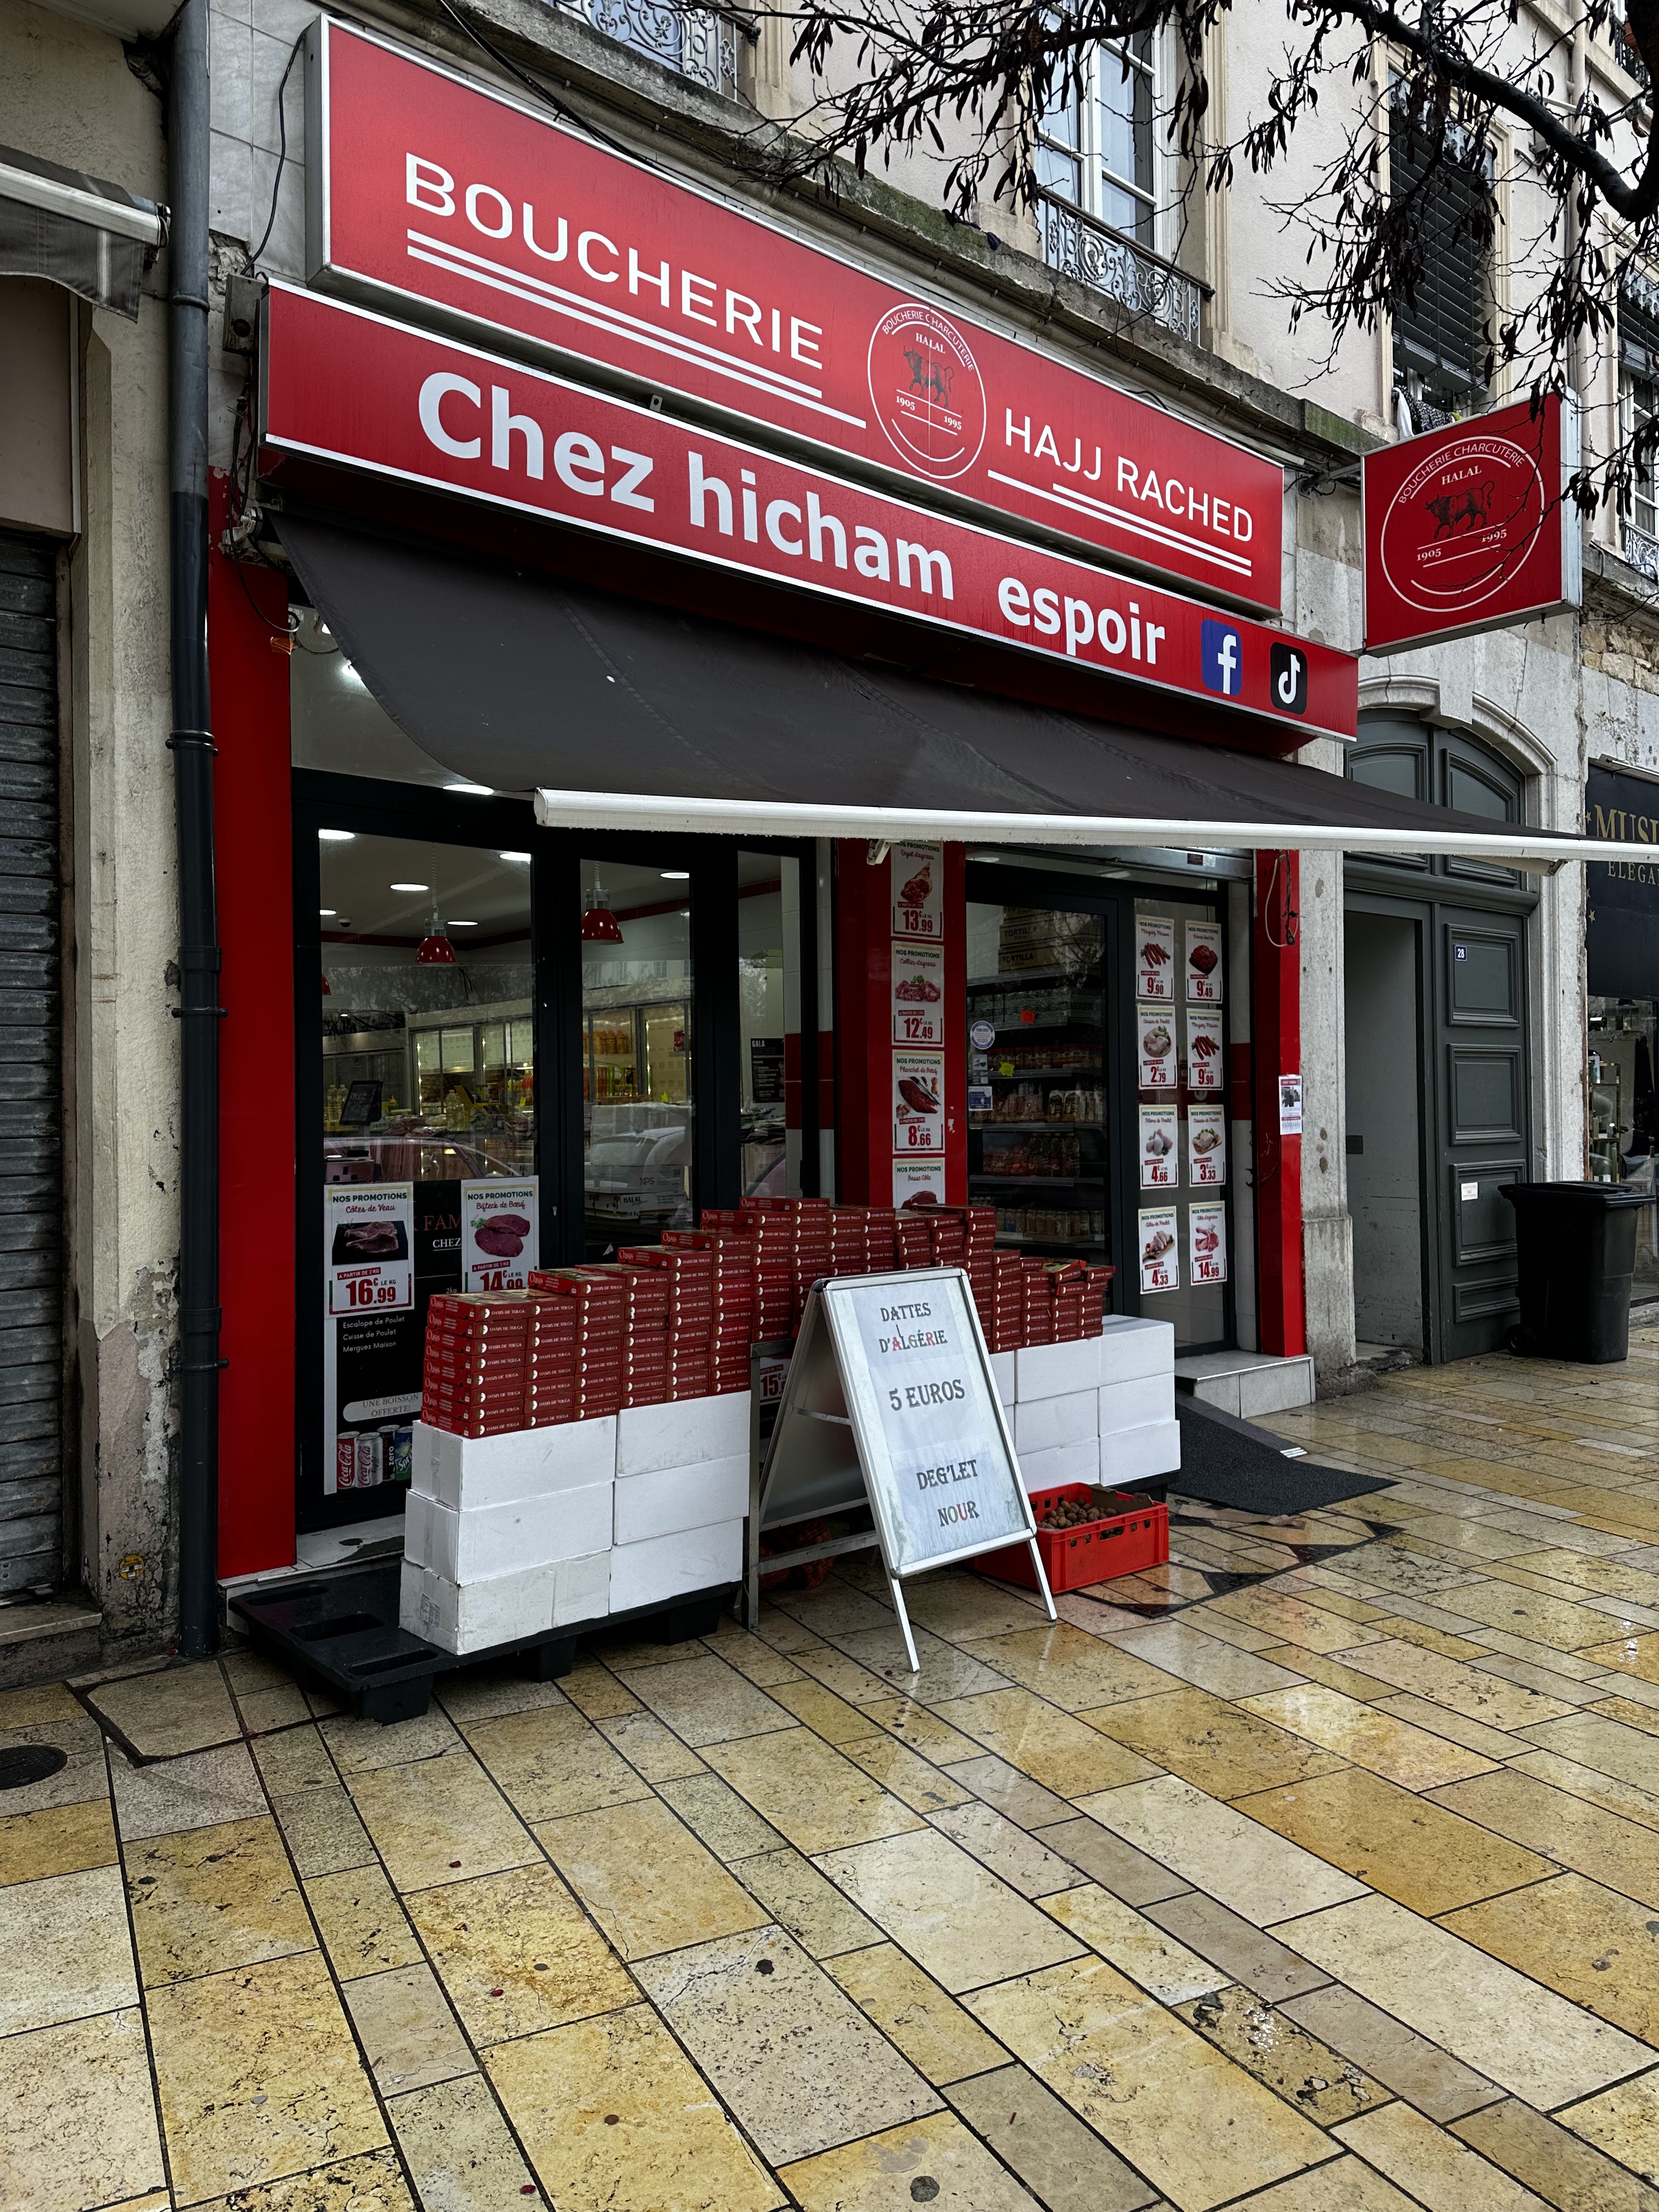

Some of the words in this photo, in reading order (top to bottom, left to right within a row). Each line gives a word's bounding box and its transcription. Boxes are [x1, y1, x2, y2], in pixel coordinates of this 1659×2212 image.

[405, 152, 822, 370] BOUCHERIE
[882, 310, 923, 335] BOUCHERIE
[925, 314, 974, 372] CHARCUTERIE
[915, 332, 946, 354] HALAL
[896, 396, 915, 411] 1905
[944, 415, 962, 430] 1995
[1005, 408, 1102, 481] HAJJ
[1117, 455, 1253, 543] RACHED
[1398, 451, 1452, 504] BOUCHERIE
[1454, 442, 1525, 467] CHARCUTERIE
[1441, 465, 1482, 486] HALAL
[418, 371, 654, 513] Chez
[688, 450, 954, 601] hicham
[998, 575, 1166, 664] espoir
[1416, 548, 1442, 561] 1905
[1481, 528, 1508, 544] 1995
[907, 842, 940, 852] PROMOTIONS
[907, 950, 940, 959] PROMOTIONS
[1457, 948, 1465, 958] 28
[352, 1192, 407, 1203] PROMOTIONS
[485, 1190, 533, 1200] PROMOTIONS
[346, 1205, 366, 1214] Côtes
[476, 1201, 499, 1212] Bifteck
[509, 1200, 526, 1210] Bœuf
[432, 1238, 461, 1248] CHEZ
[343, 1320, 373, 1329] Escalope
[385, 1315, 405, 1324] Poulet
[879, 1302, 932, 1322] DATTES
[376, 1328, 397, 1337] Poulet
[878, 1329, 948, 1353] D'ALGÉRIE
[343, 1344, 371, 1353] Merguez
[363, 1400, 381, 1408] UNE
[382, 1393, 419, 1404] BOISSON
[888, 1387, 902, 1411] 5
[905, 1379, 966, 1409] EUROS
[371, 1404, 411, 1417] OFFERTE!
[916, 1459, 979, 1491] DEG'LET
[937, 1500, 980, 1527] NOUR
